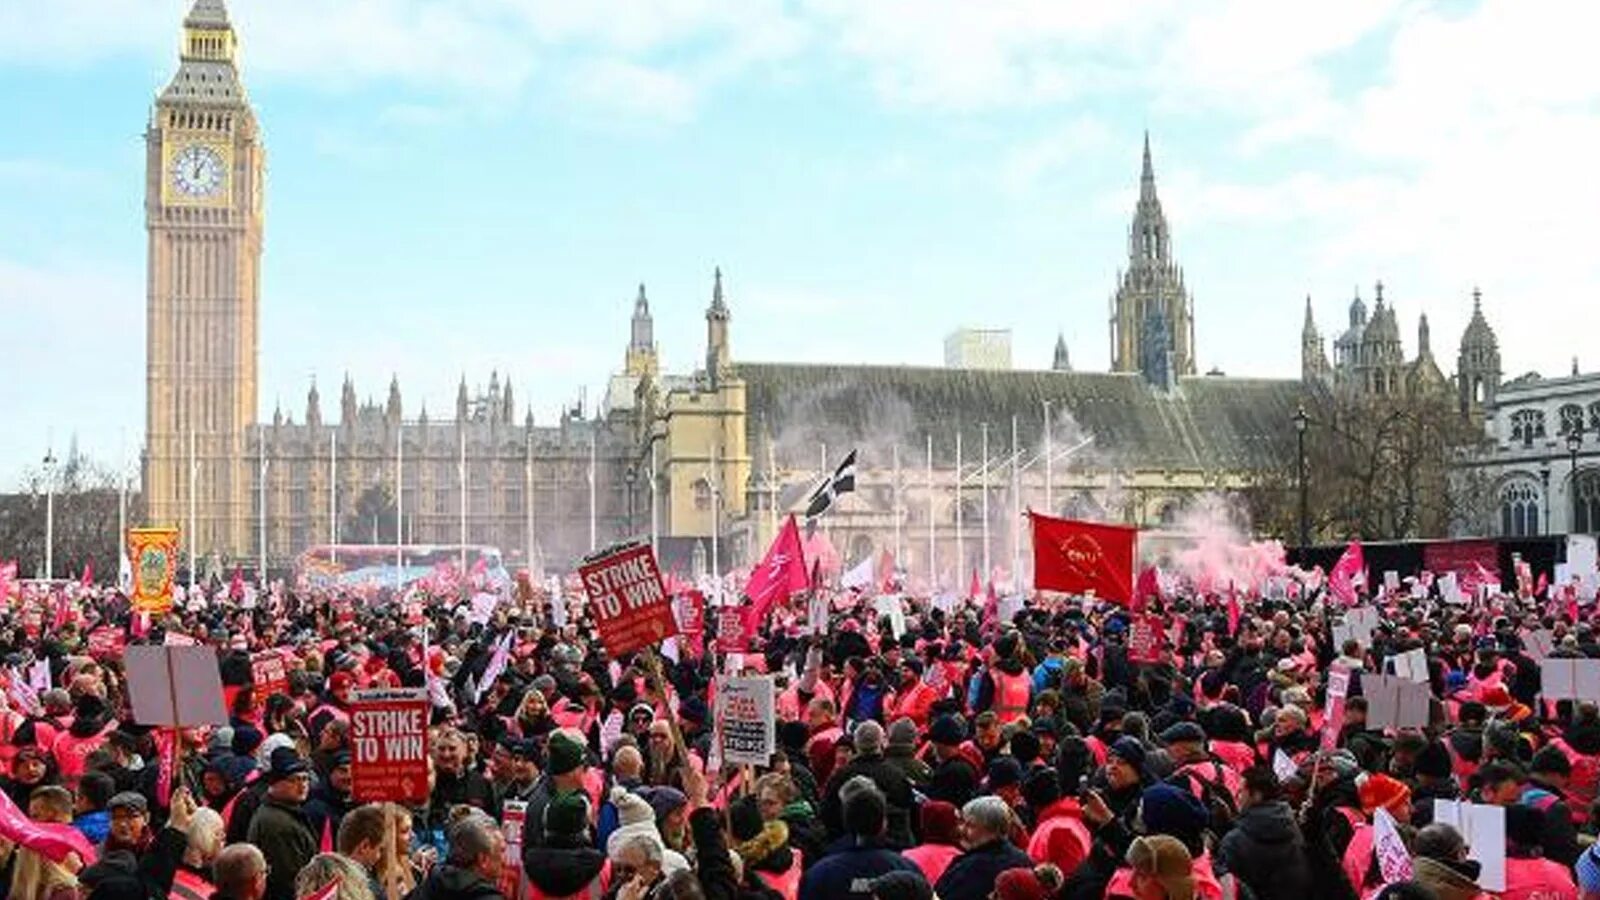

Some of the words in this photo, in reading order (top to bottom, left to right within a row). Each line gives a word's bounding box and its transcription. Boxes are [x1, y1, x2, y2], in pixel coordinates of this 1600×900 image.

[586, 554, 656, 596] STRIKE
[593, 593, 621, 620] TO
[622, 578, 664, 609] WIN
[352, 709, 423, 737] STRIKE
[353, 736, 379, 762] TO
[384, 735, 424, 761] WIN
